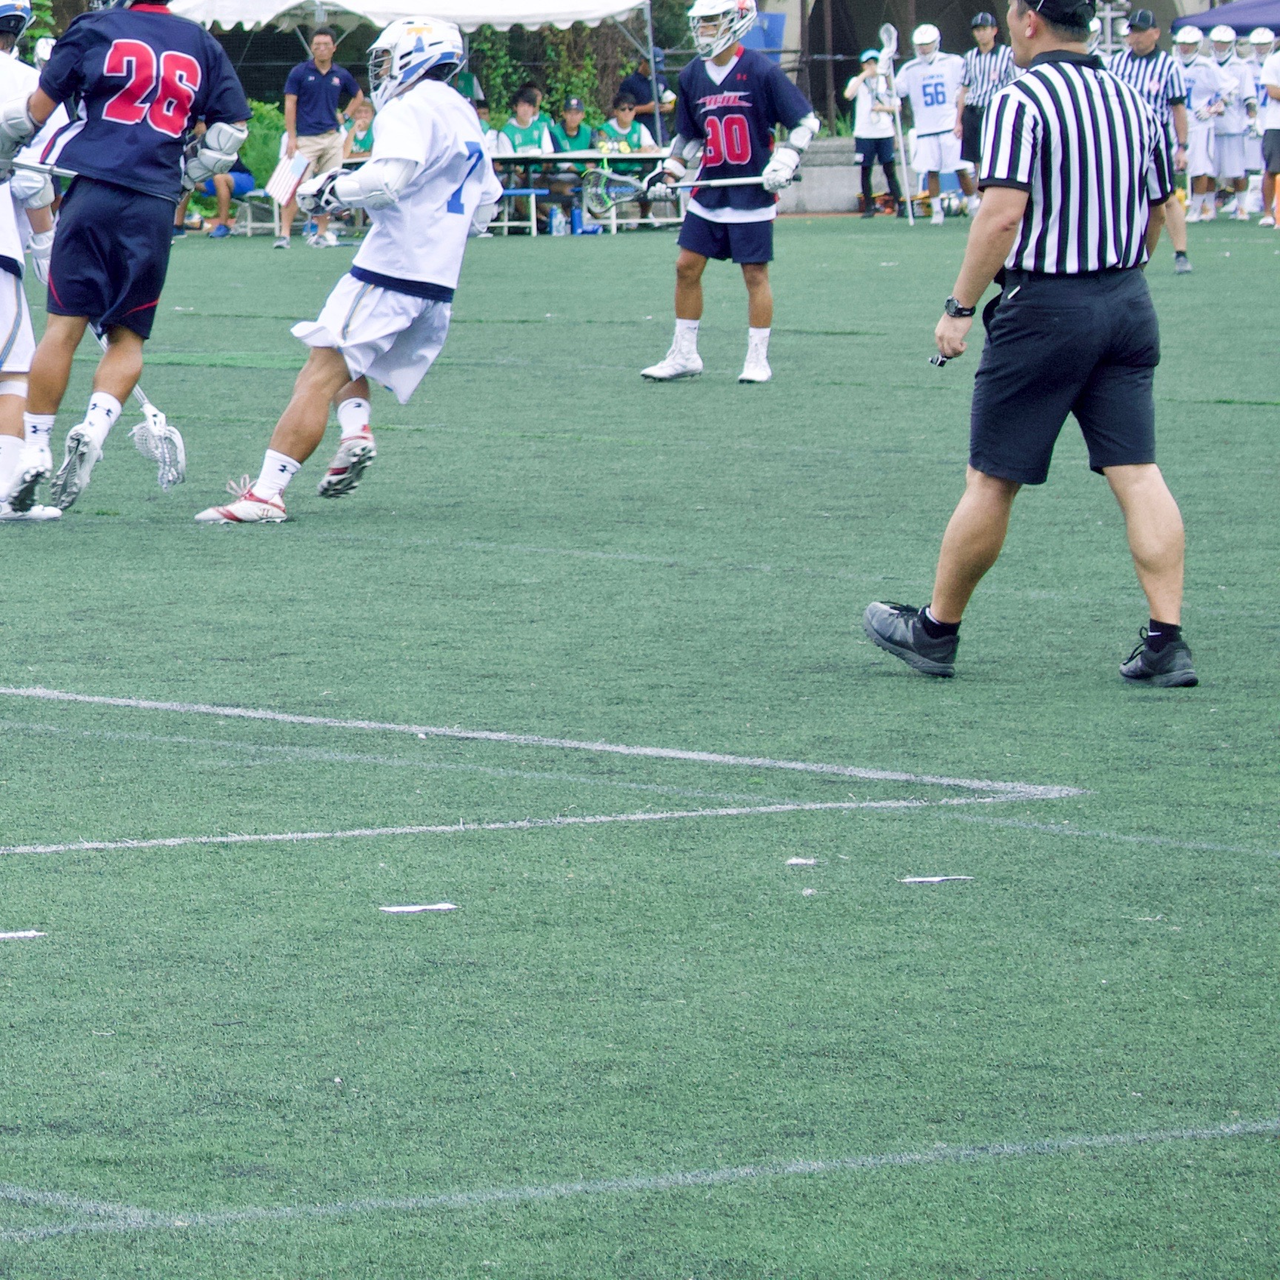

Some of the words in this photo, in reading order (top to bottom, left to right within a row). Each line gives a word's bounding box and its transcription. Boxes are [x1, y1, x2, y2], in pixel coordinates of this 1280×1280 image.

[102, 39, 202, 139] 26
[922, 82, 946, 107] 56
[447, 141, 484, 215] 7
